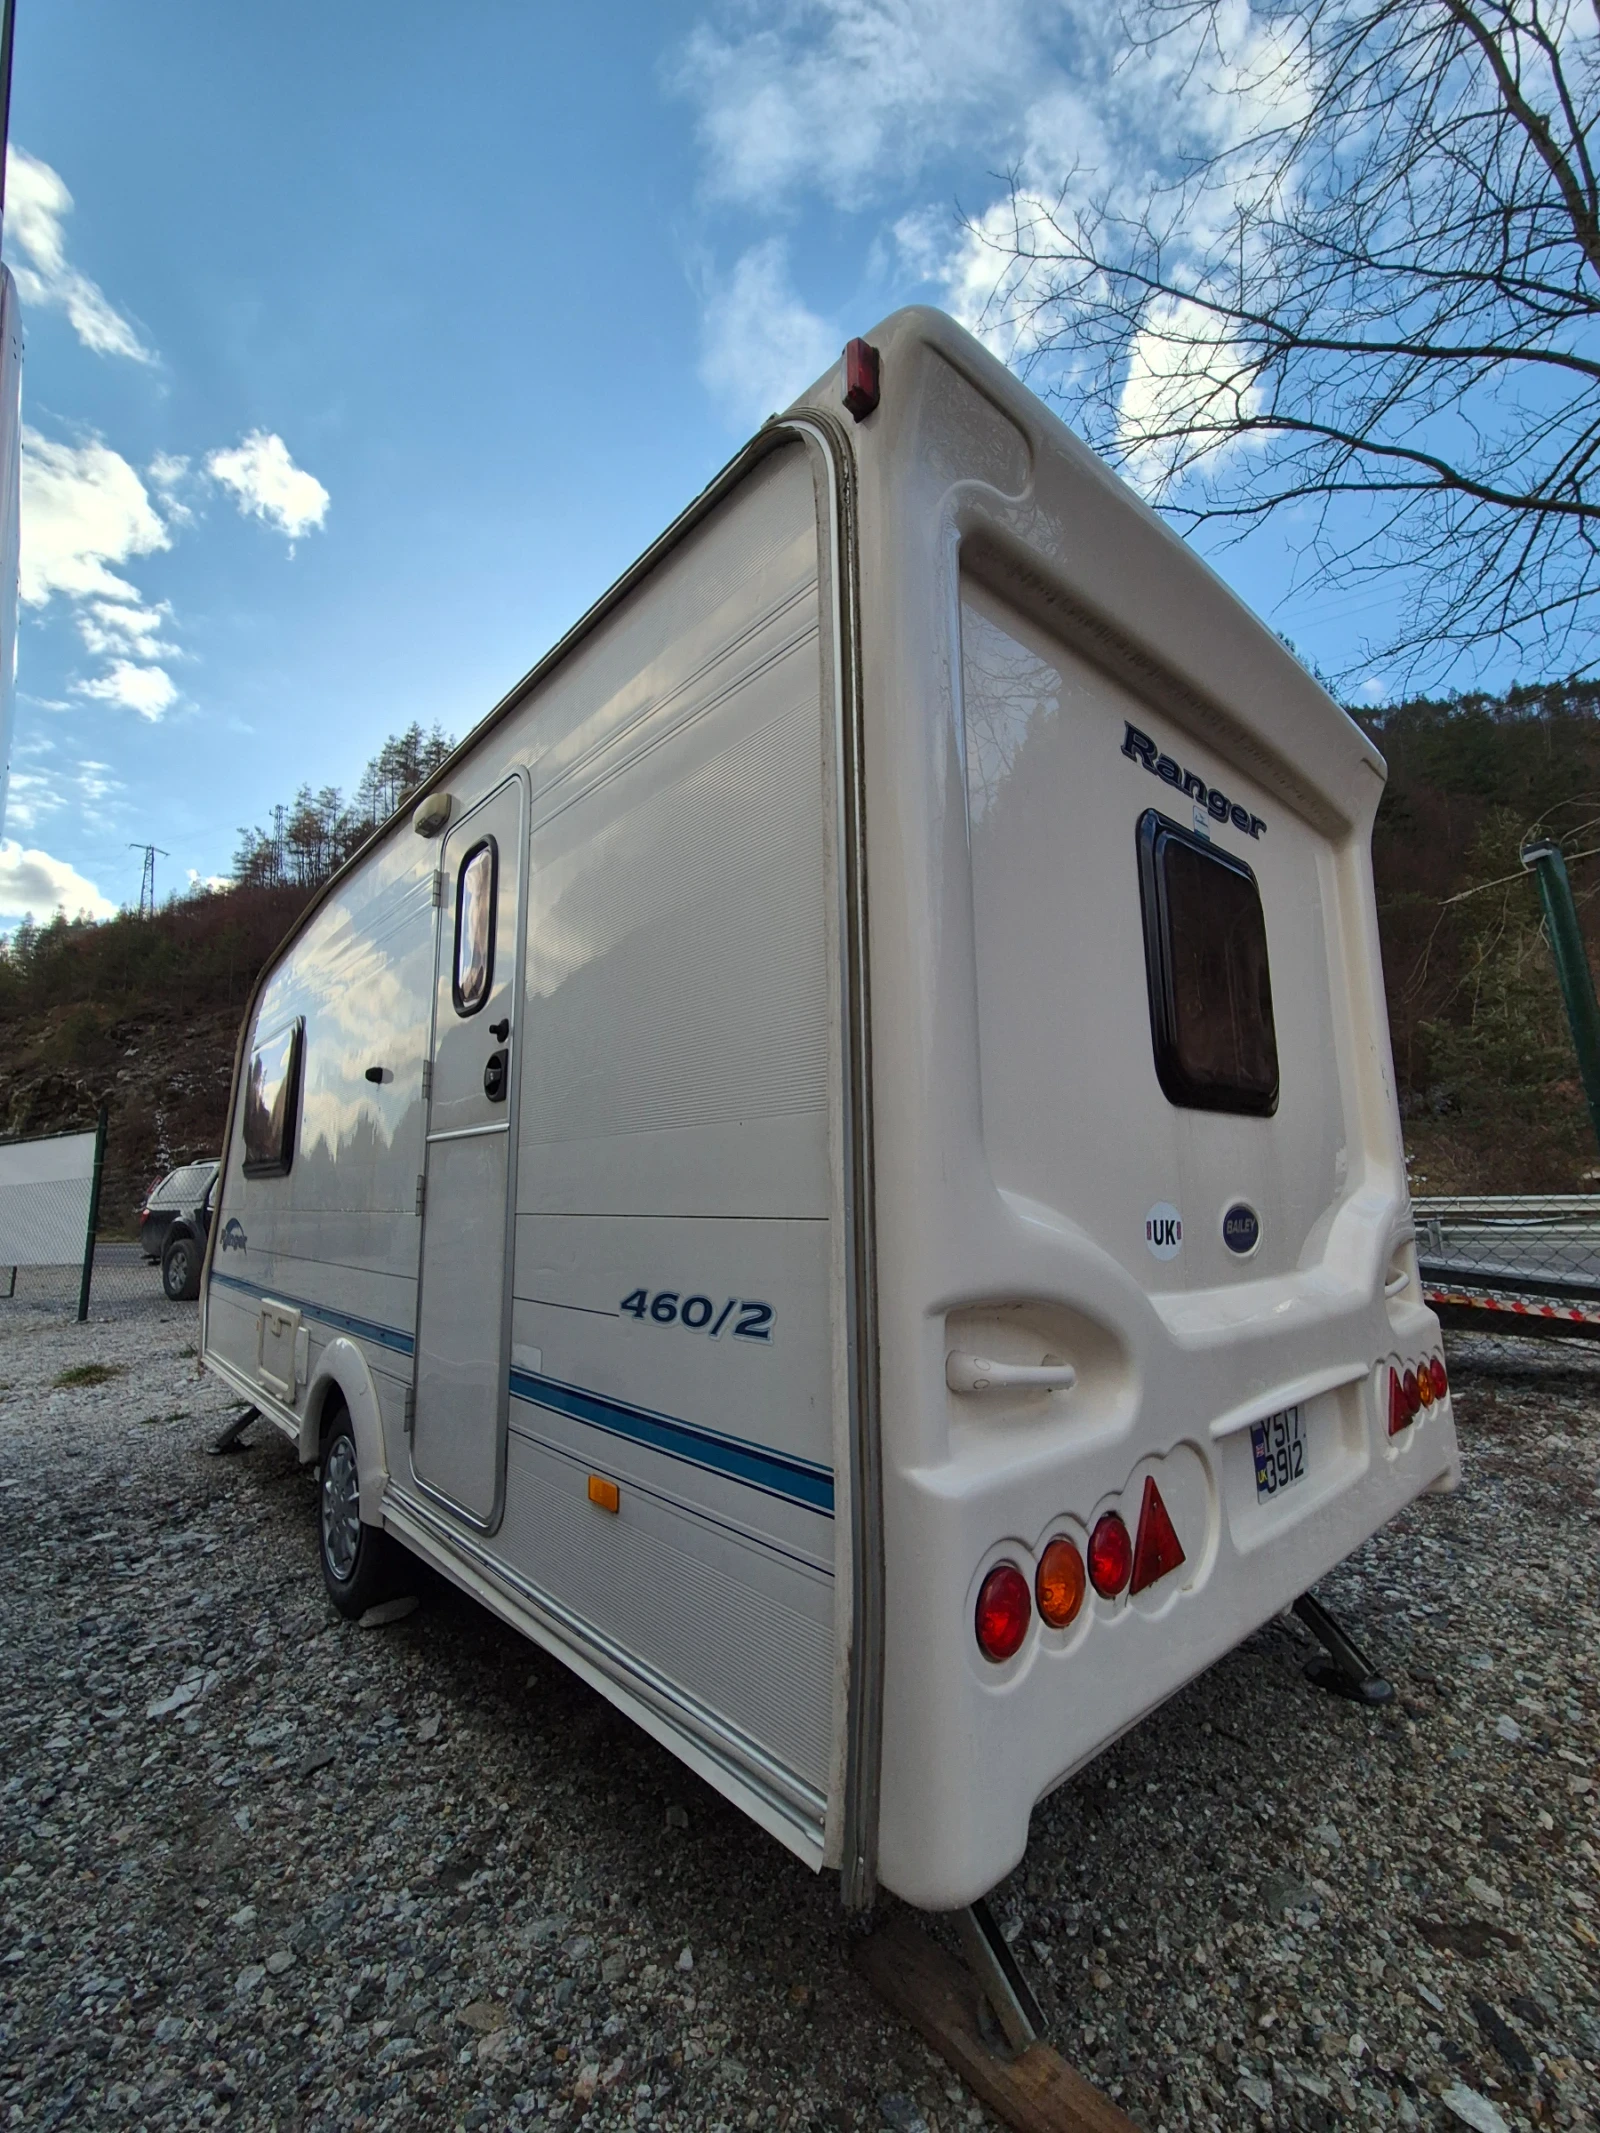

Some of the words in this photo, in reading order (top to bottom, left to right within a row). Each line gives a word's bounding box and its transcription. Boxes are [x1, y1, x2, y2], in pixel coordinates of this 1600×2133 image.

[1121, 720, 1267, 840] Ranger
[1153, 1219, 1176, 1246] UK
[1226, 1218, 1256, 1235] BAILEY
[620, 1288, 773, 1343] 460/2
[1257, 1469, 1268, 1484] UK
[1265, 1439, 1304, 1494] 3912
